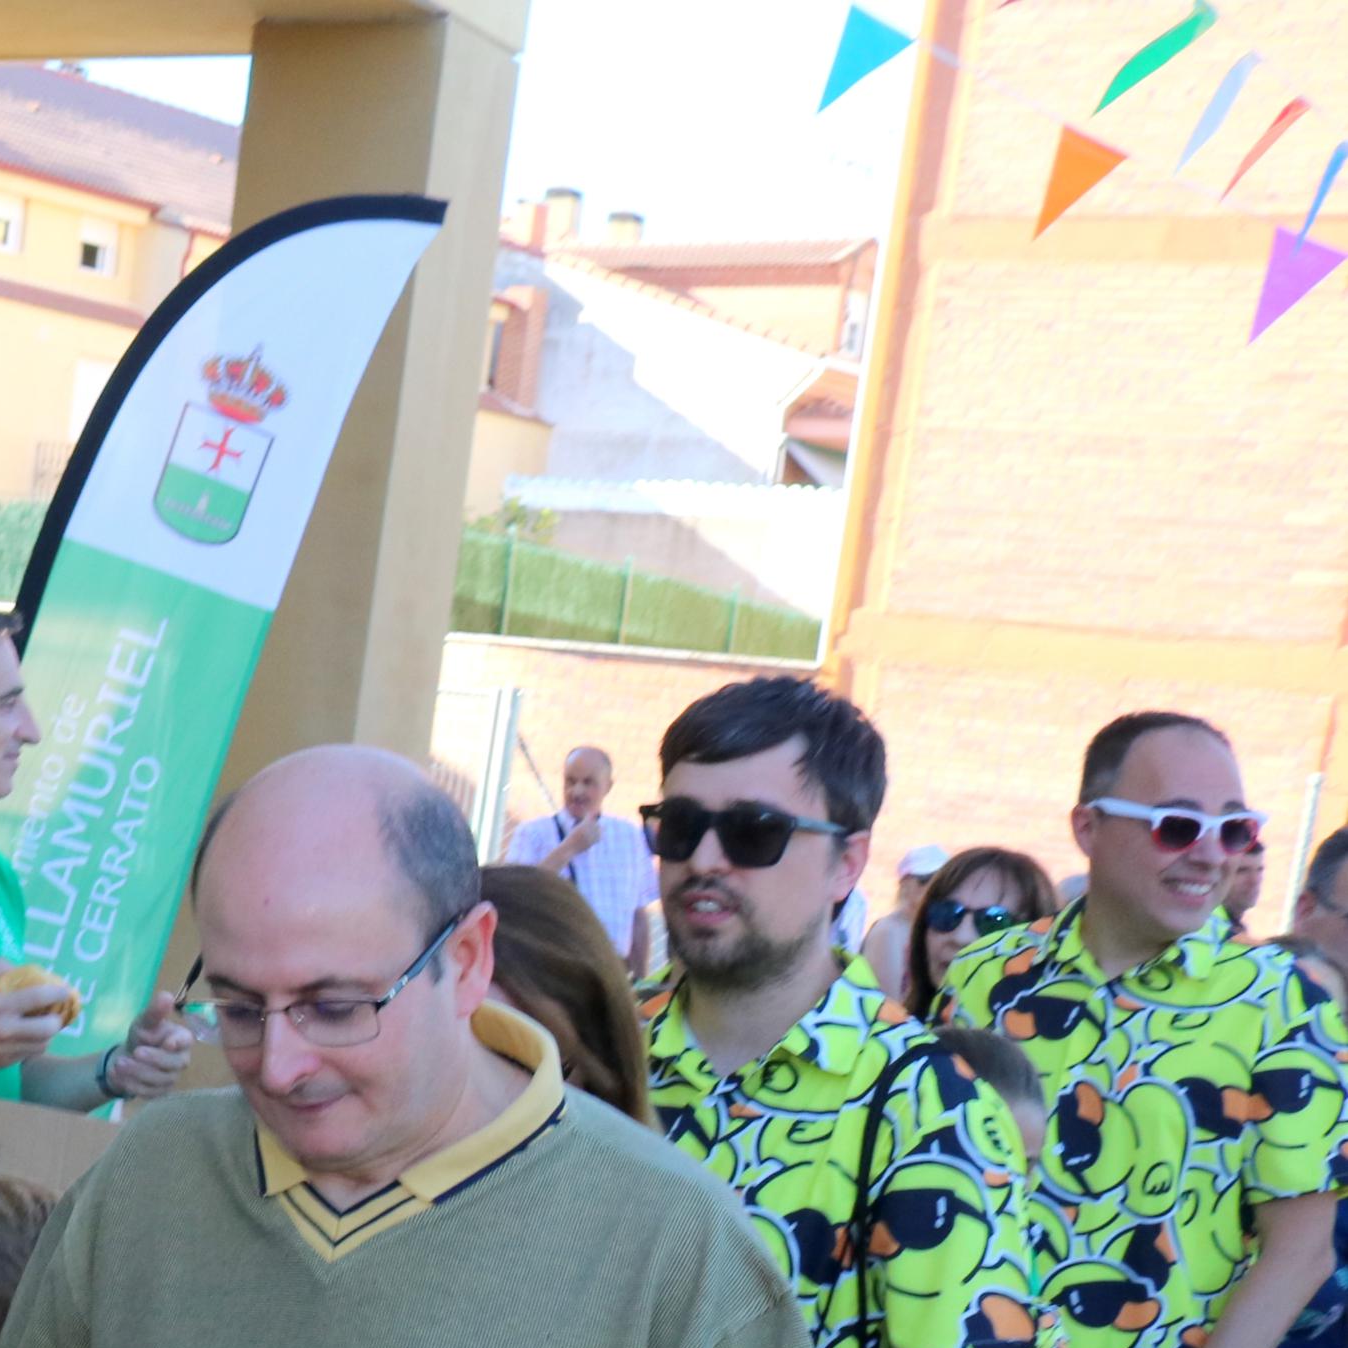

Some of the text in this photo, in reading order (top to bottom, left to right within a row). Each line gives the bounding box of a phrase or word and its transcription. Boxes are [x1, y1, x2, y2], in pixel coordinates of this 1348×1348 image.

[12, 752, 67, 887] miento
[51, 691, 87, 746] de
[22, 617, 170, 962] LLAMURIEL
[73, 755, 162, 963] CERRATO
